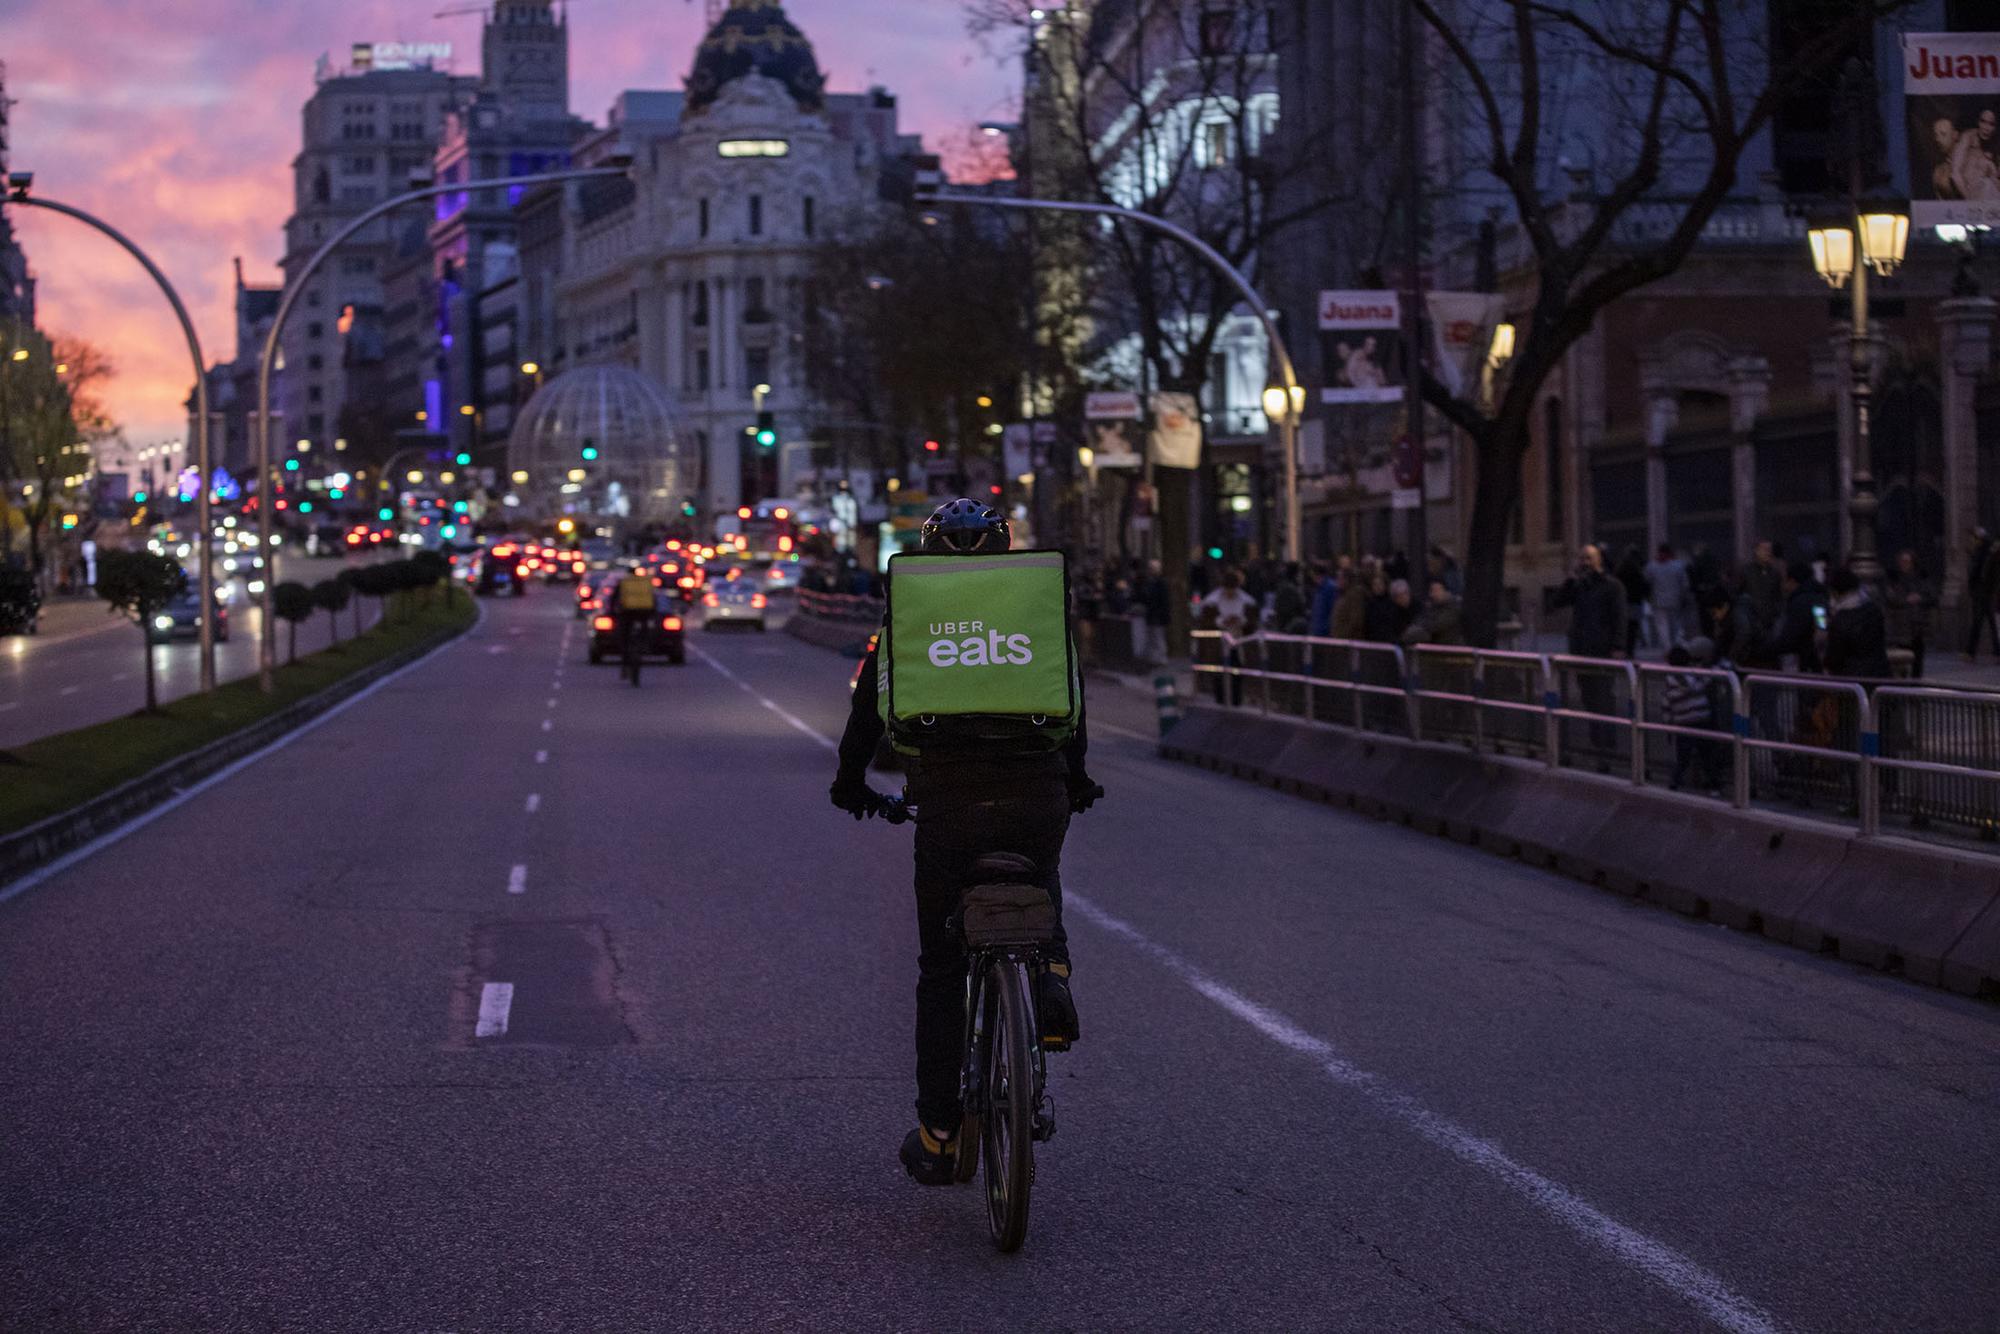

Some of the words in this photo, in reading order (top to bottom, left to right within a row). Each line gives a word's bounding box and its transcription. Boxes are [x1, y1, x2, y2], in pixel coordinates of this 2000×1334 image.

[1324, 302, 1393, 320] Juana
[929, 620, 984, 635] UBER
[928, 629, 1033, 667] eats
